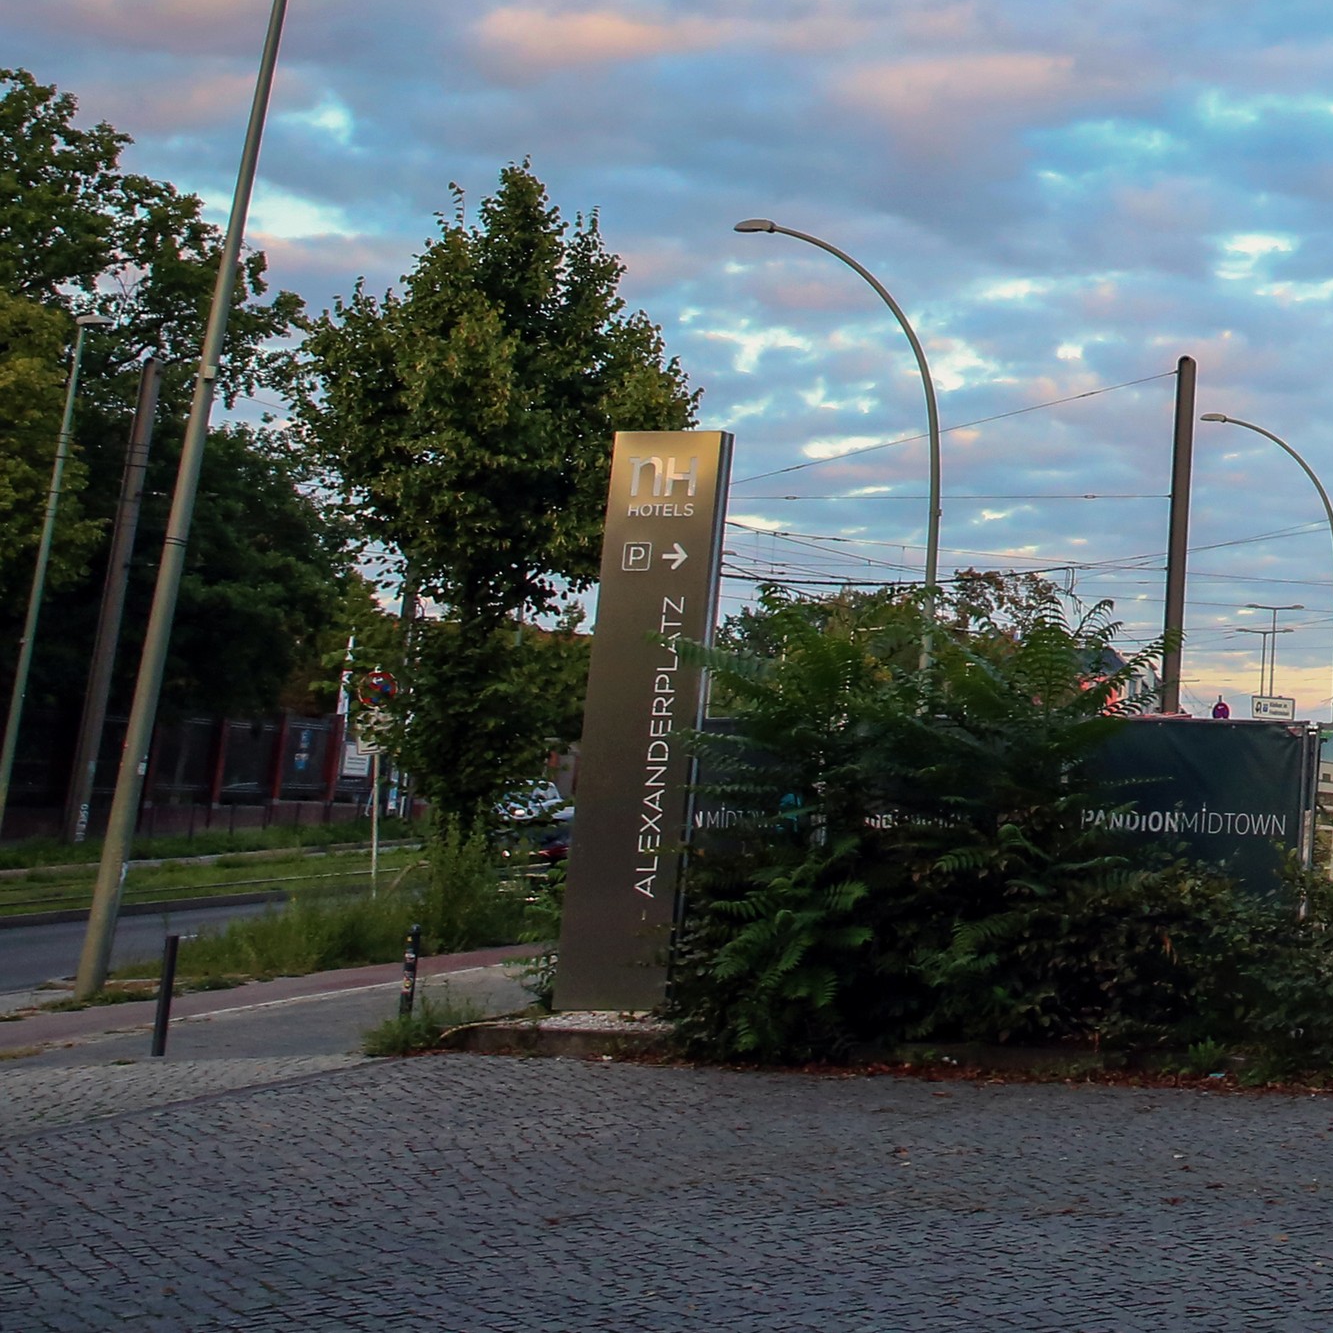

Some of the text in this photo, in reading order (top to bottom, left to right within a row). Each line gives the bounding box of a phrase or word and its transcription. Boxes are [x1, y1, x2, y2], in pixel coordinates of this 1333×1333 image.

[627, 503, 694, 517] HOTELS
[628, 546, 645, 566] P
[633, 596, 685, 898] ALEXANDERPLATZ
